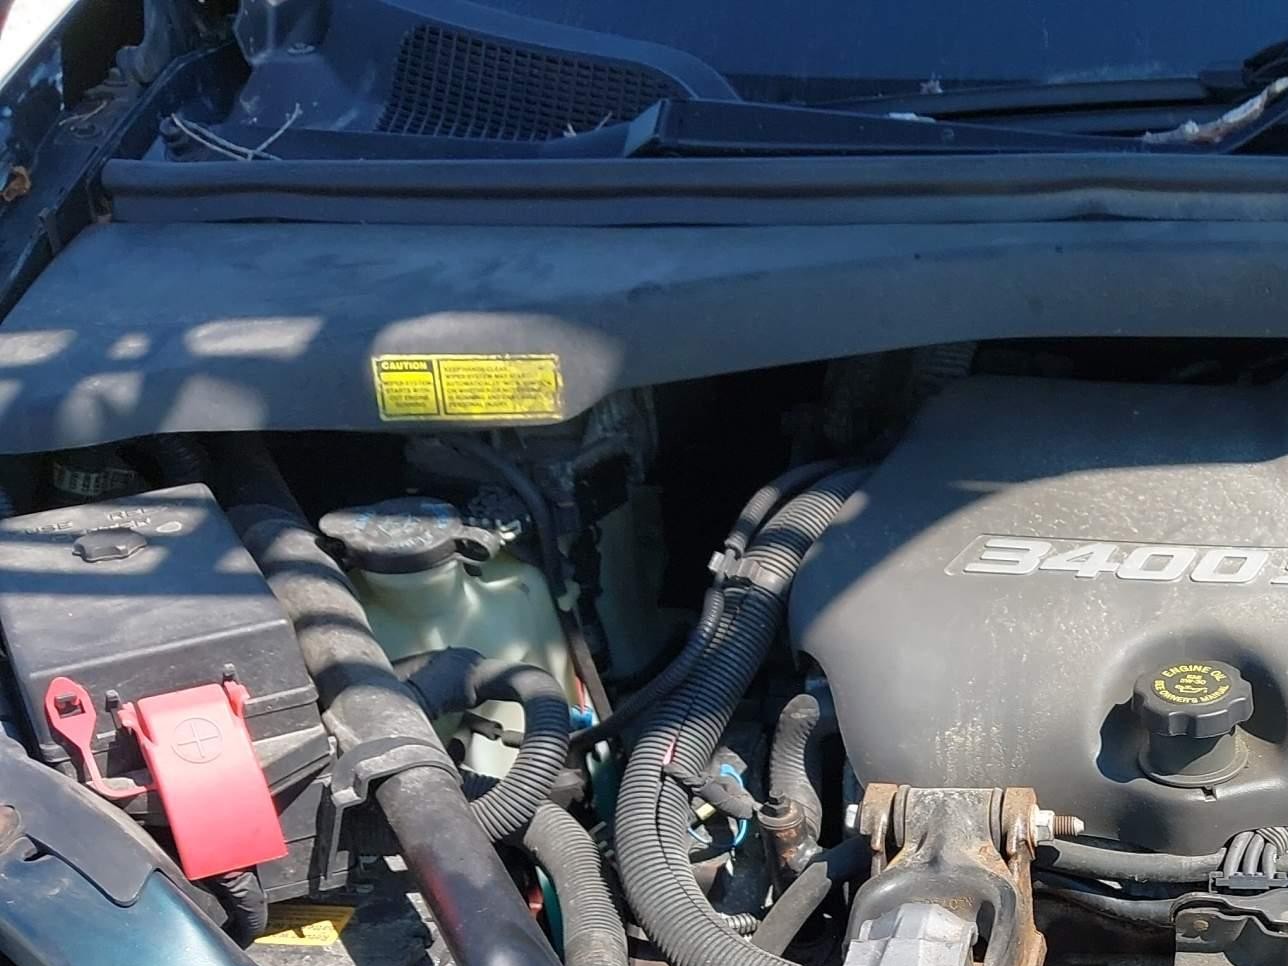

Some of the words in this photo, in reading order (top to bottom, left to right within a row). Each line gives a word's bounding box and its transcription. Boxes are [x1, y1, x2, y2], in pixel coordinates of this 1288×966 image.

[381, 361, 428, 370] CAUTION
[963, 540, 1269, 583] 3400
[1161, 664, 1212, 678] ENGINE
[1210, 670, 1227, 682] OIL
